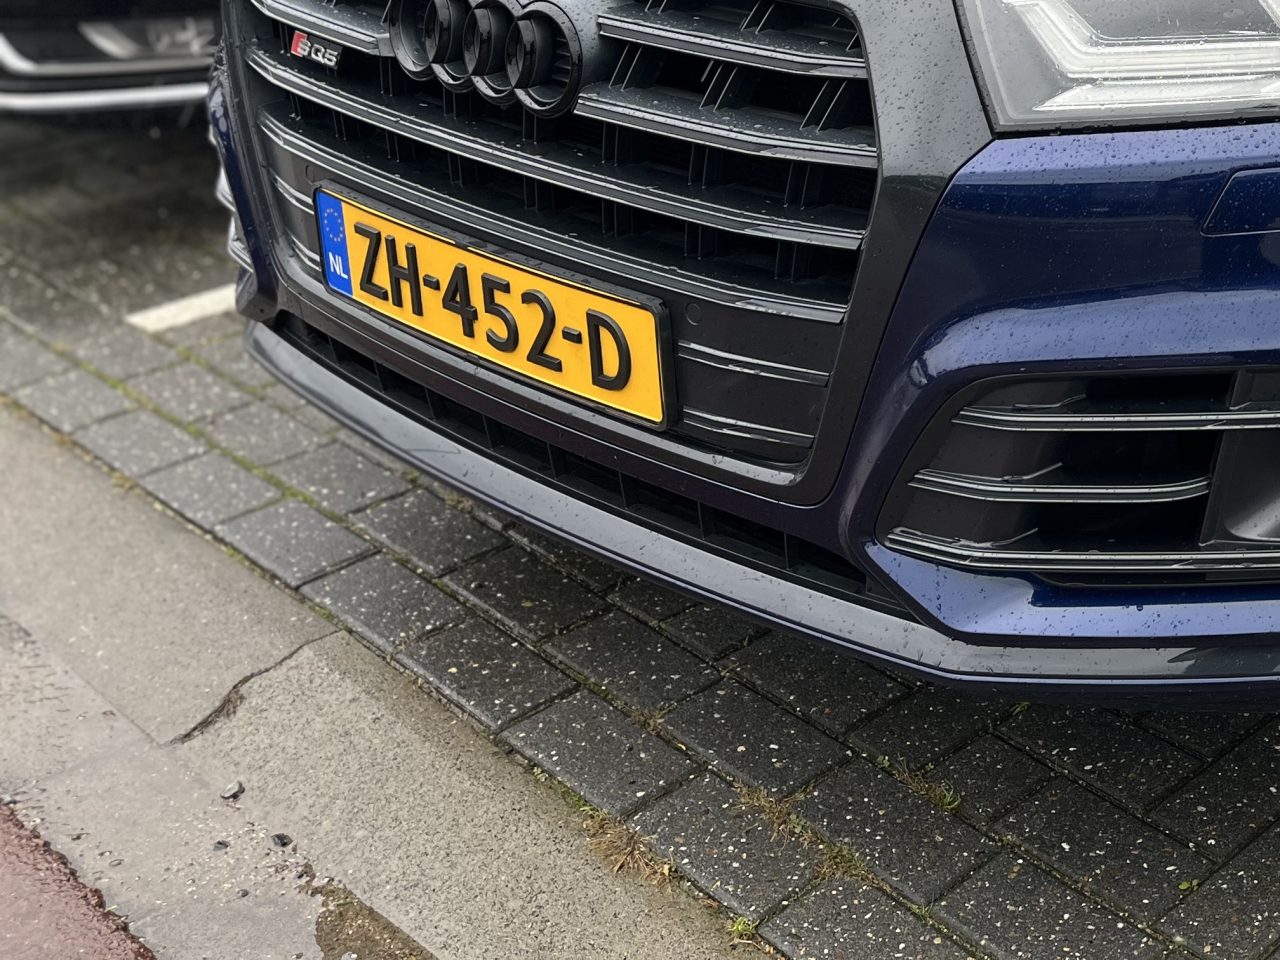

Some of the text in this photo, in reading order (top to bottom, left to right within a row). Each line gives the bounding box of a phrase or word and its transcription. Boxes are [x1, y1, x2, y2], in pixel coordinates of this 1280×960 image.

[296, 38, 338, 66] SQ5
[328, 251, 349, 280] NL
[354, 221, 632, 391] ZH-452-D
